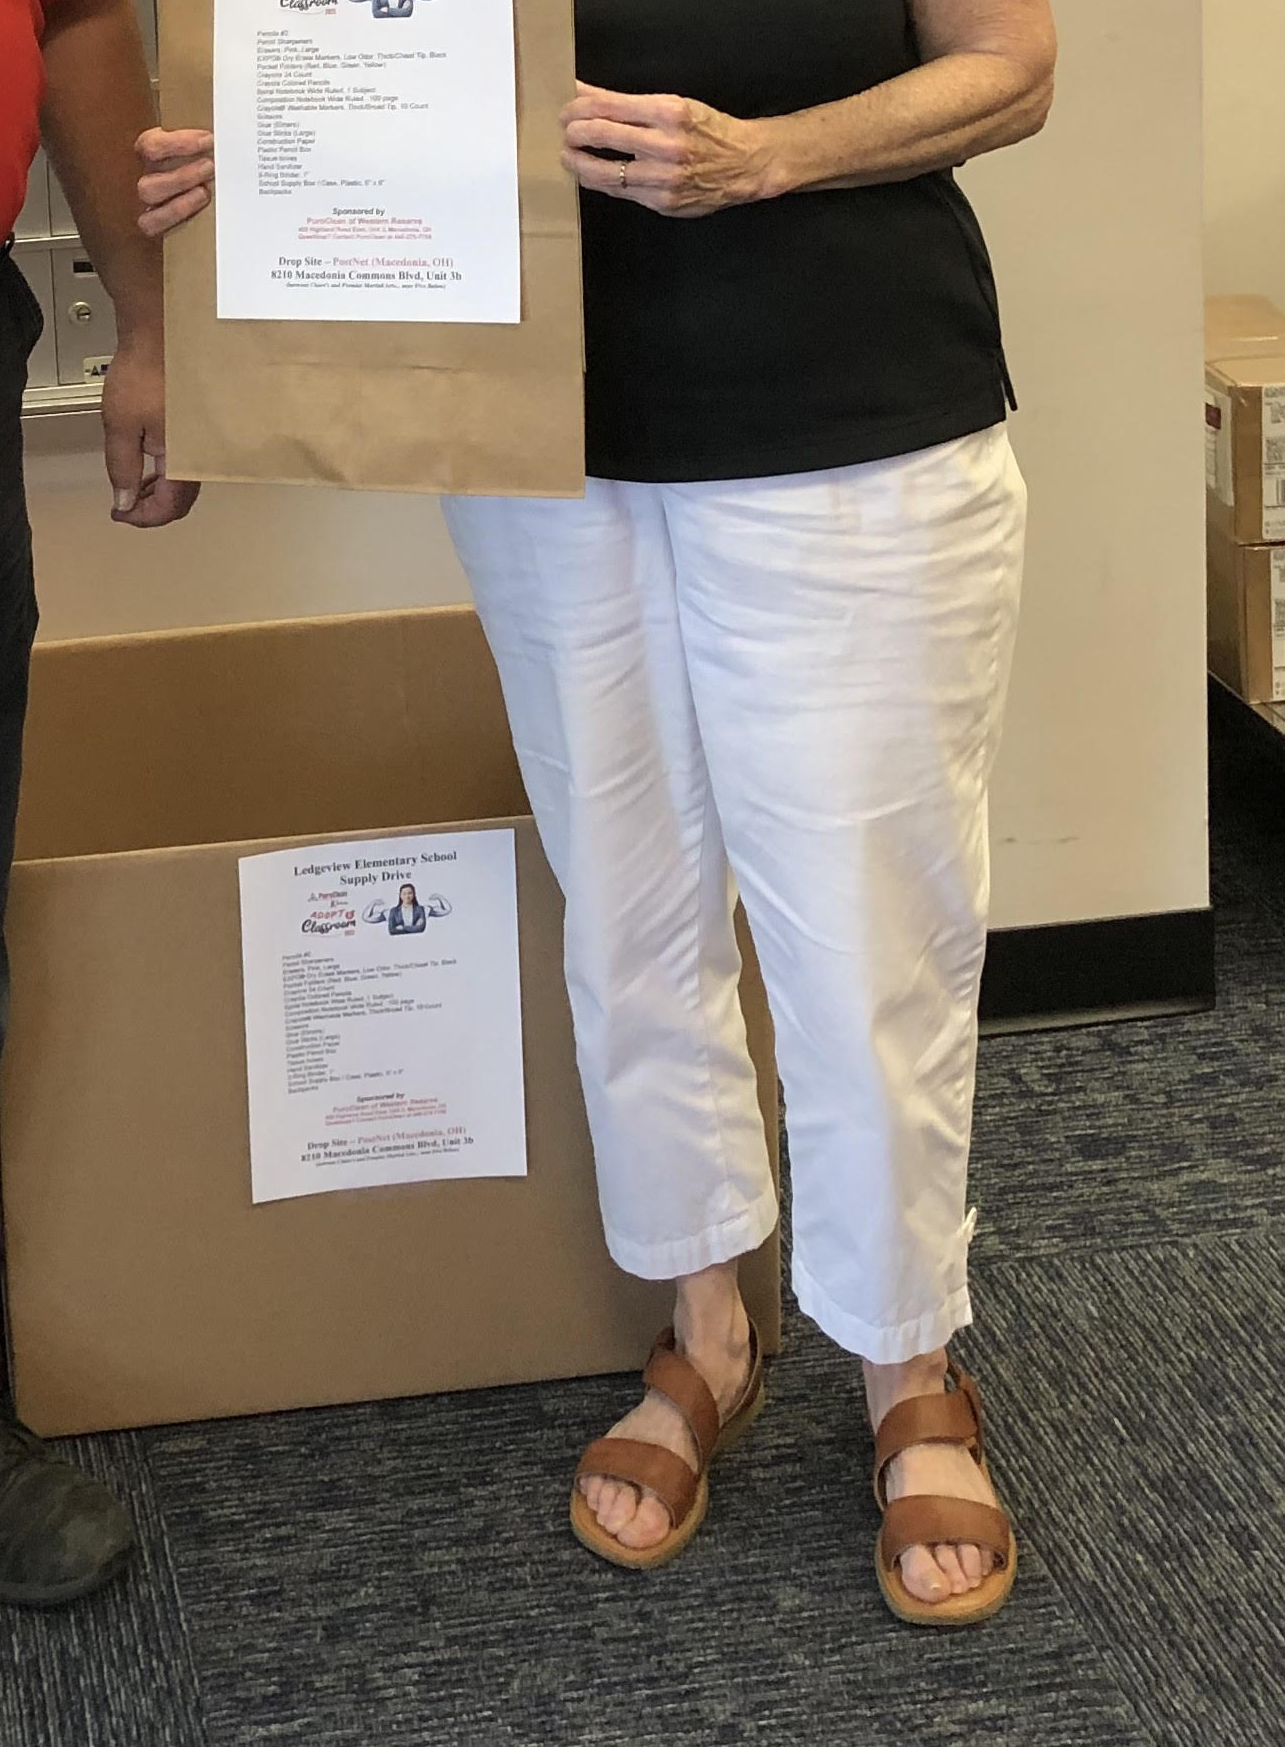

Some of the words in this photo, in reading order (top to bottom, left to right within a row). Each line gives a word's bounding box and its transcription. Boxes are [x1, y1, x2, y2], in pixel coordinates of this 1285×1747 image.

[279, 256, 302, 268] Drop
[305, 256, 322, 266] Site
[333, 257, 368, 267] PostNet
[372, 257, 430, 268] (Macedonia,
[433, 257, 453, 267] OH)
[271, 269, 292, 279] 8210
[295, 270, 345, 279] Macedonia
[348, 270, 395, 280] Commons
[398, 270, 424, 281] Blvd,
[426, 270, 446, 280] Unit
[294, 862, 351, 877] Ledgeview
[354, 855, 418, 870] Elementary
[420, 851, 457, 863] School
[339, 873, 379, 887] Supply
[381, 870, 412, 882] Drive
[307, 1141, 330, 1151] Drop
[331, 1138, 348, 1147] Site
[323, 1147, 370, 1159] Macedonia
[372, 1143, 416, 1154] Commons
